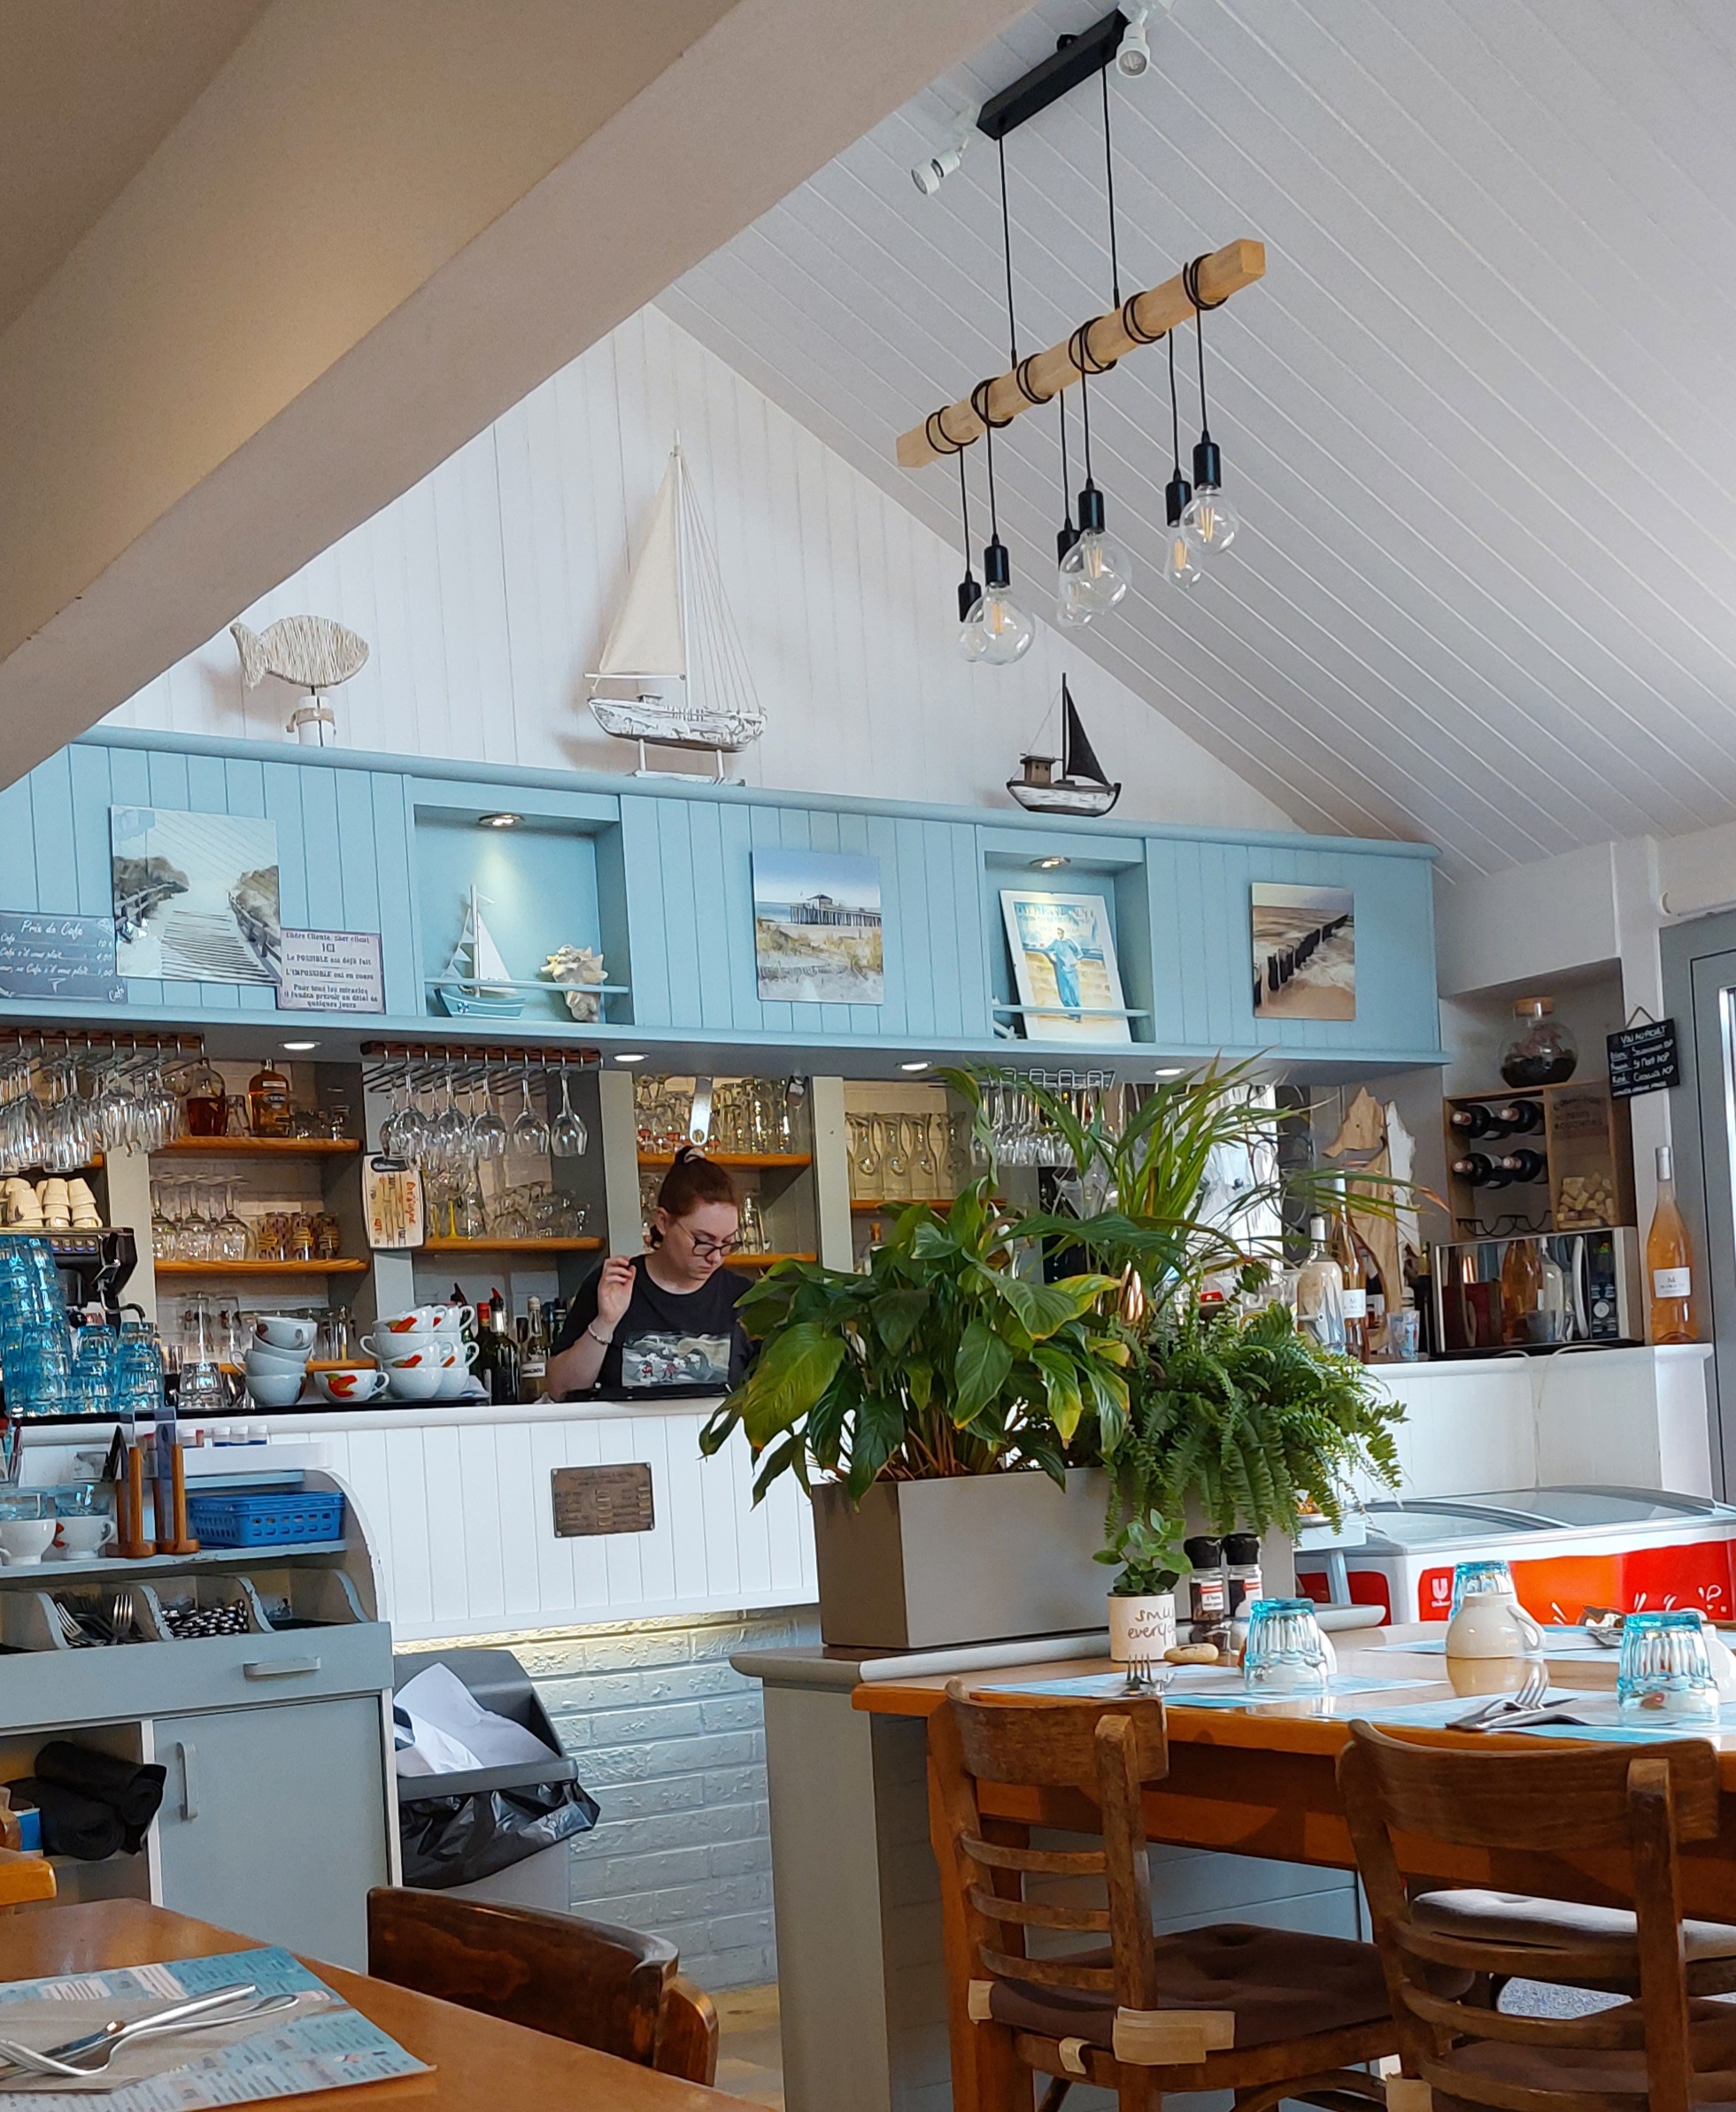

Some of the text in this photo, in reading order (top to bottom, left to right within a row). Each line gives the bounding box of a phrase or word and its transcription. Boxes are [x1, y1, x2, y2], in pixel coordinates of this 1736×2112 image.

[322, 943, 336, 952] ICI
[297, 954, 329, 963] POSSIBLE
[286, 967, 332, 978] L'IMPOSSIBLE
